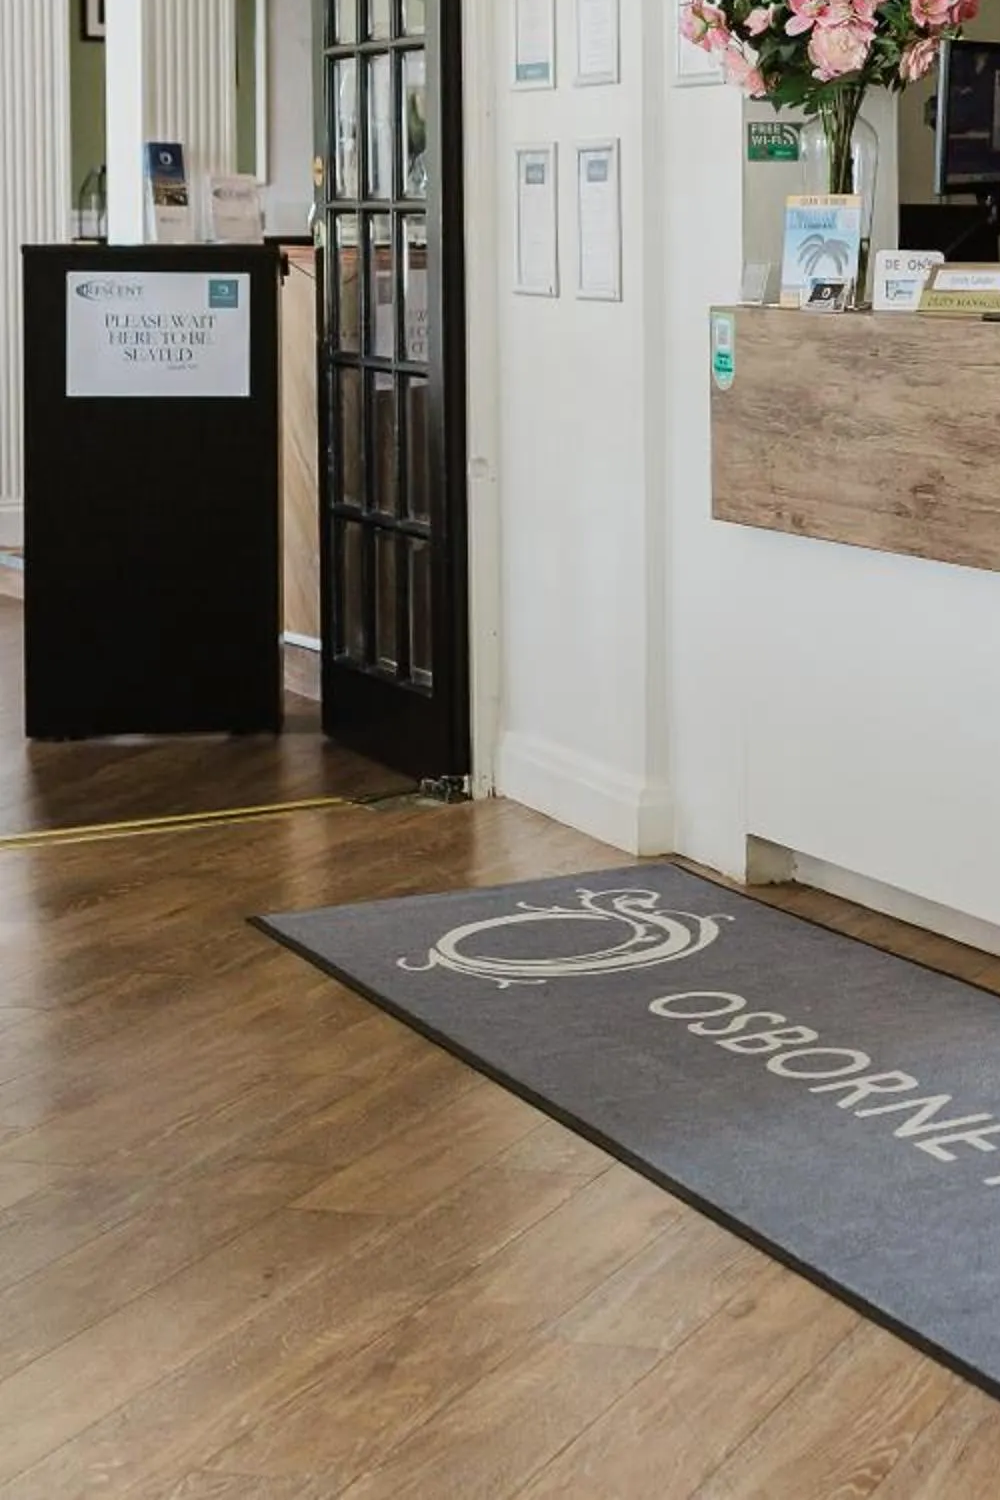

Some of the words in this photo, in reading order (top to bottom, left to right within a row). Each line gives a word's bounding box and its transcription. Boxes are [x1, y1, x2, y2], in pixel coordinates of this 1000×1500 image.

[751, 123, 781, 135] FREE
[105, 313, 168, 329] PLEASE
[123, 348, 194, 362] SEATED
